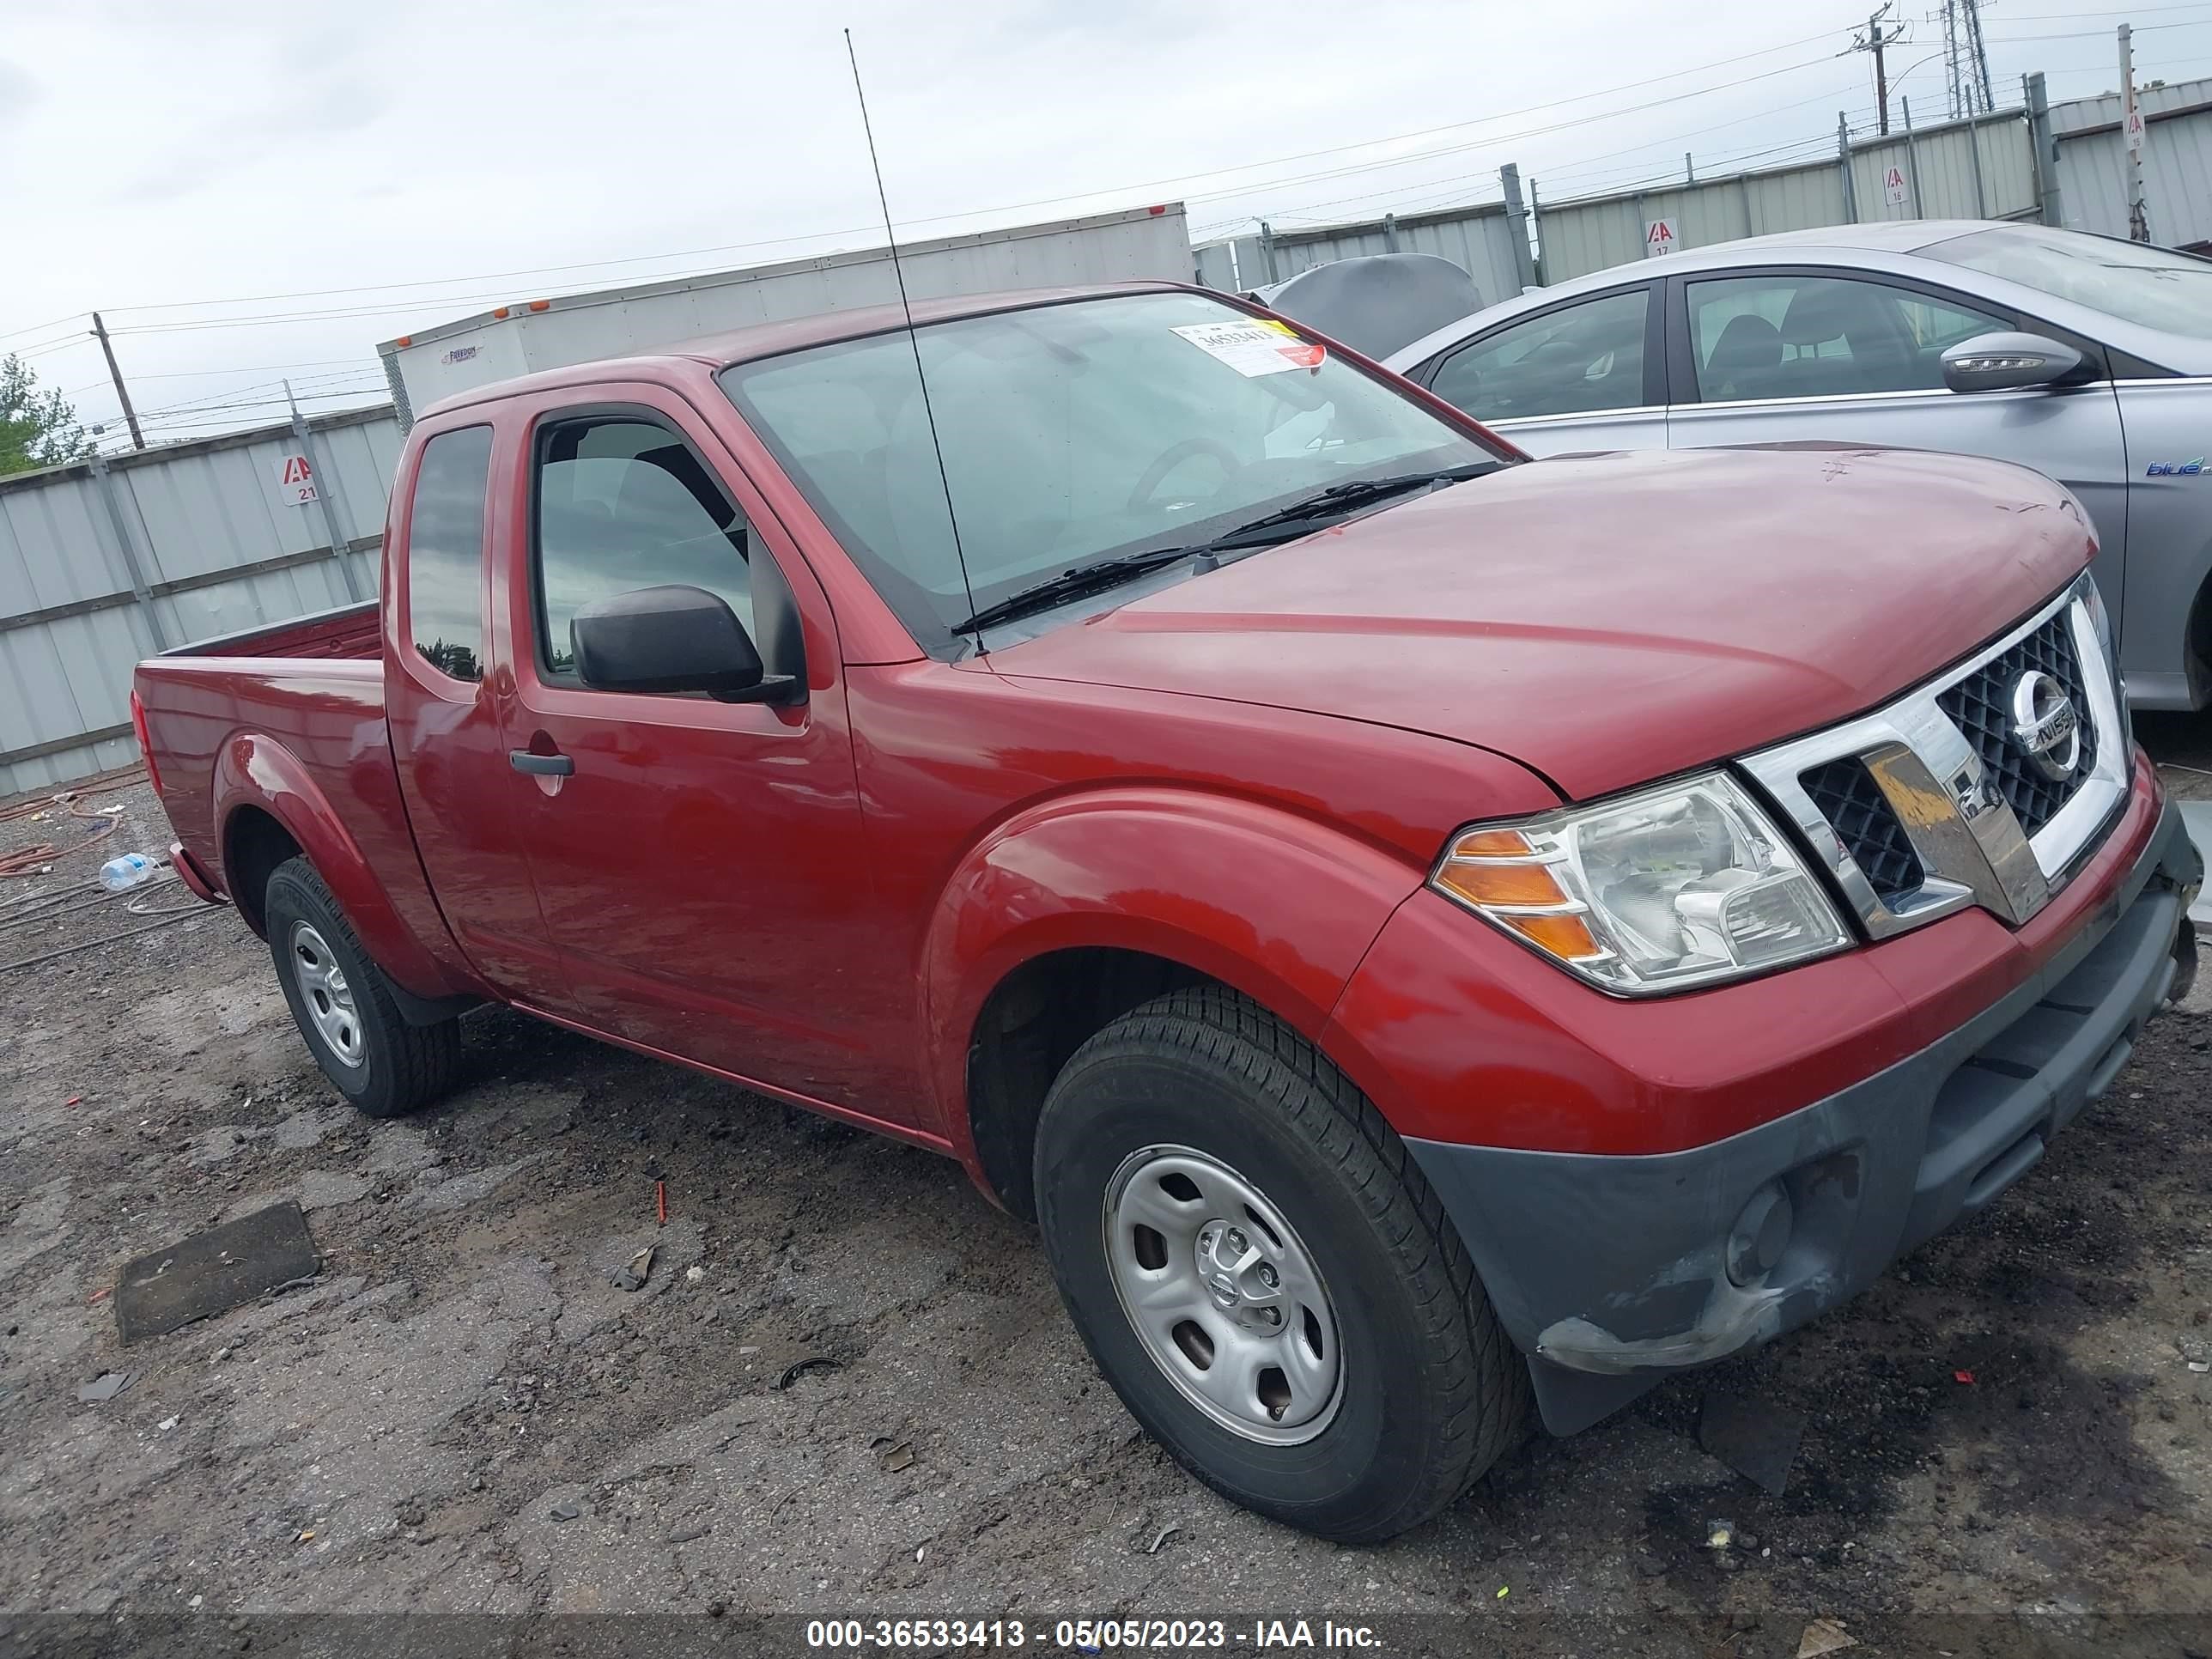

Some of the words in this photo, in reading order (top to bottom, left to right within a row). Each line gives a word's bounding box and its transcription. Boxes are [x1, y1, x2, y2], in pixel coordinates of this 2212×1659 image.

[1893, 191, 1902, 201] 16
[1656, 246, 1668, 256] 17
[1198, 330, 1274, 347] 36533413
[2146, 460, 2200, 477] blue
[298, 486, 316, 501] 21
